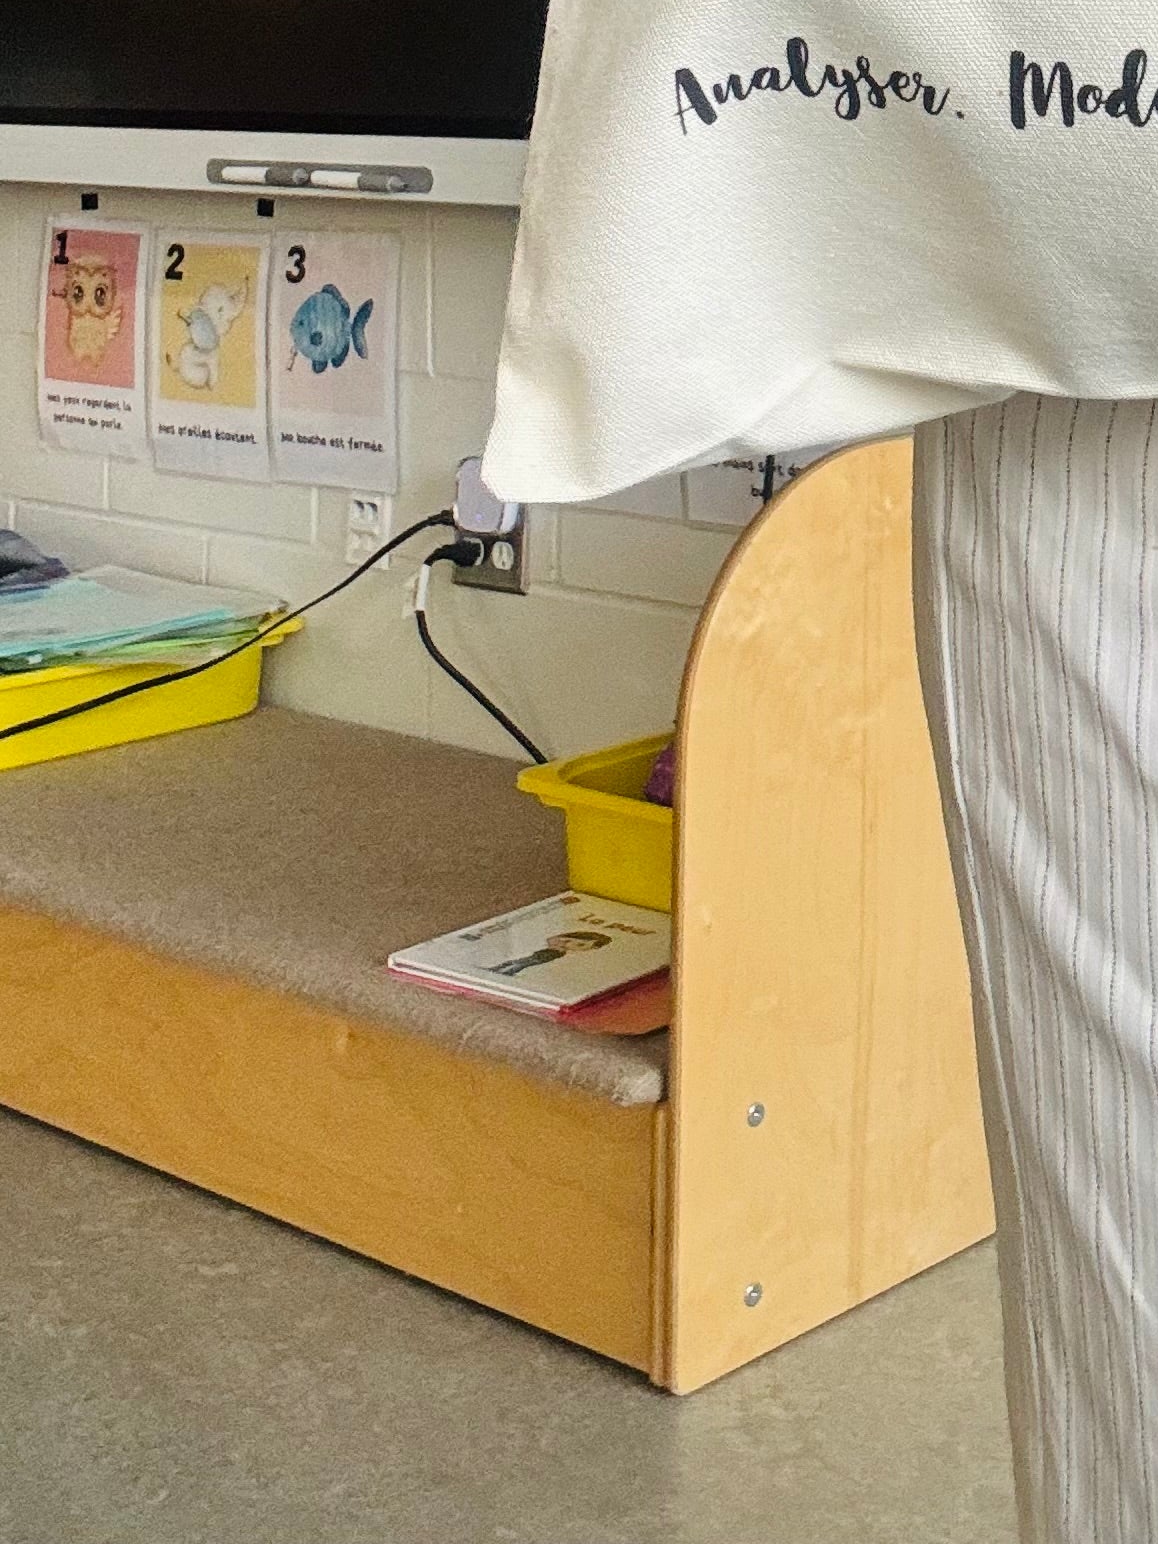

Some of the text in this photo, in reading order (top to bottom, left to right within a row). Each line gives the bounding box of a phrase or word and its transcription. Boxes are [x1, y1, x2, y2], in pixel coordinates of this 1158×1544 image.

[674, 37, 965, 135] Analyser.
[54, 230, 69, 264] 1
[165, 243, 185, 281] 2
[286, 245, 306, 284] 3
